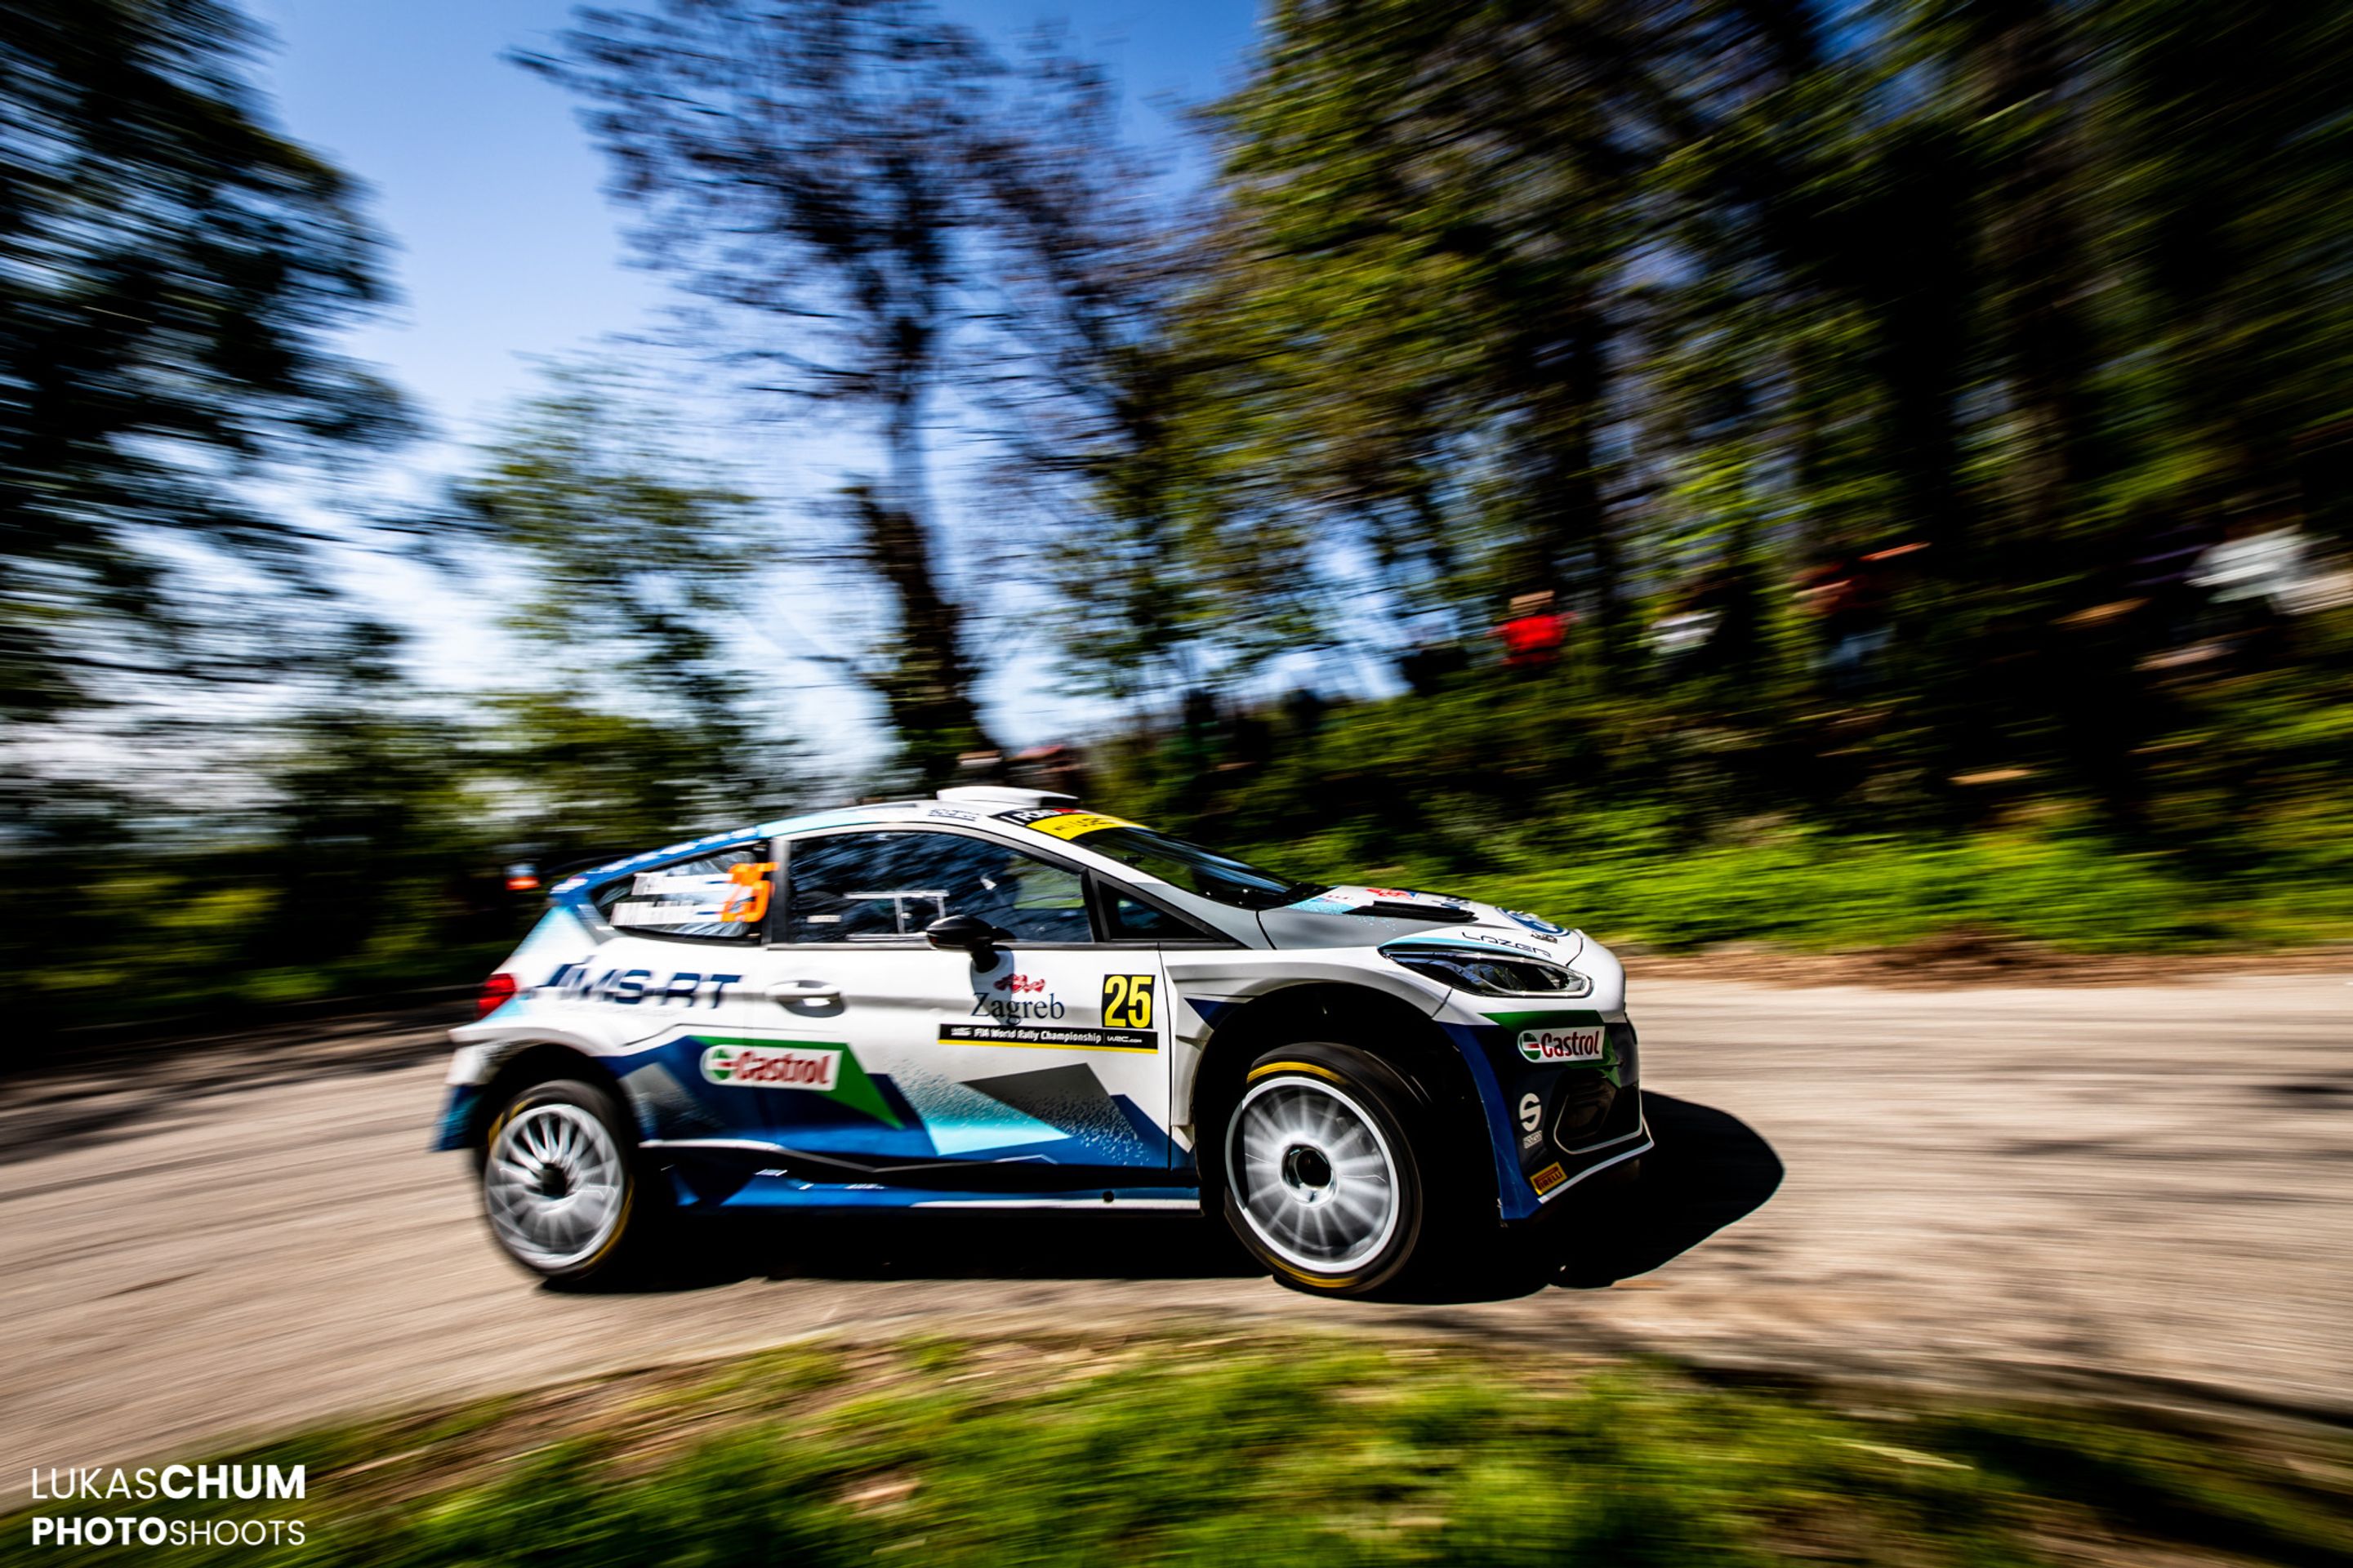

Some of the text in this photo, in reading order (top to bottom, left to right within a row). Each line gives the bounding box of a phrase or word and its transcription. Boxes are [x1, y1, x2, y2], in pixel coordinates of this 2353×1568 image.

[971, 991, 1065, 1027] Zagreb
[1104, 975, 1152, 1028] 25
[991, 1028, 1016, 1039] World
[1017, 1029, 1039, 1041] Rally
[1041, 1030, 1102, 1044] Championship
[1541, 1031, 1599, 1058] Castrol
[735, 1050, 831, 1085] Castrol
